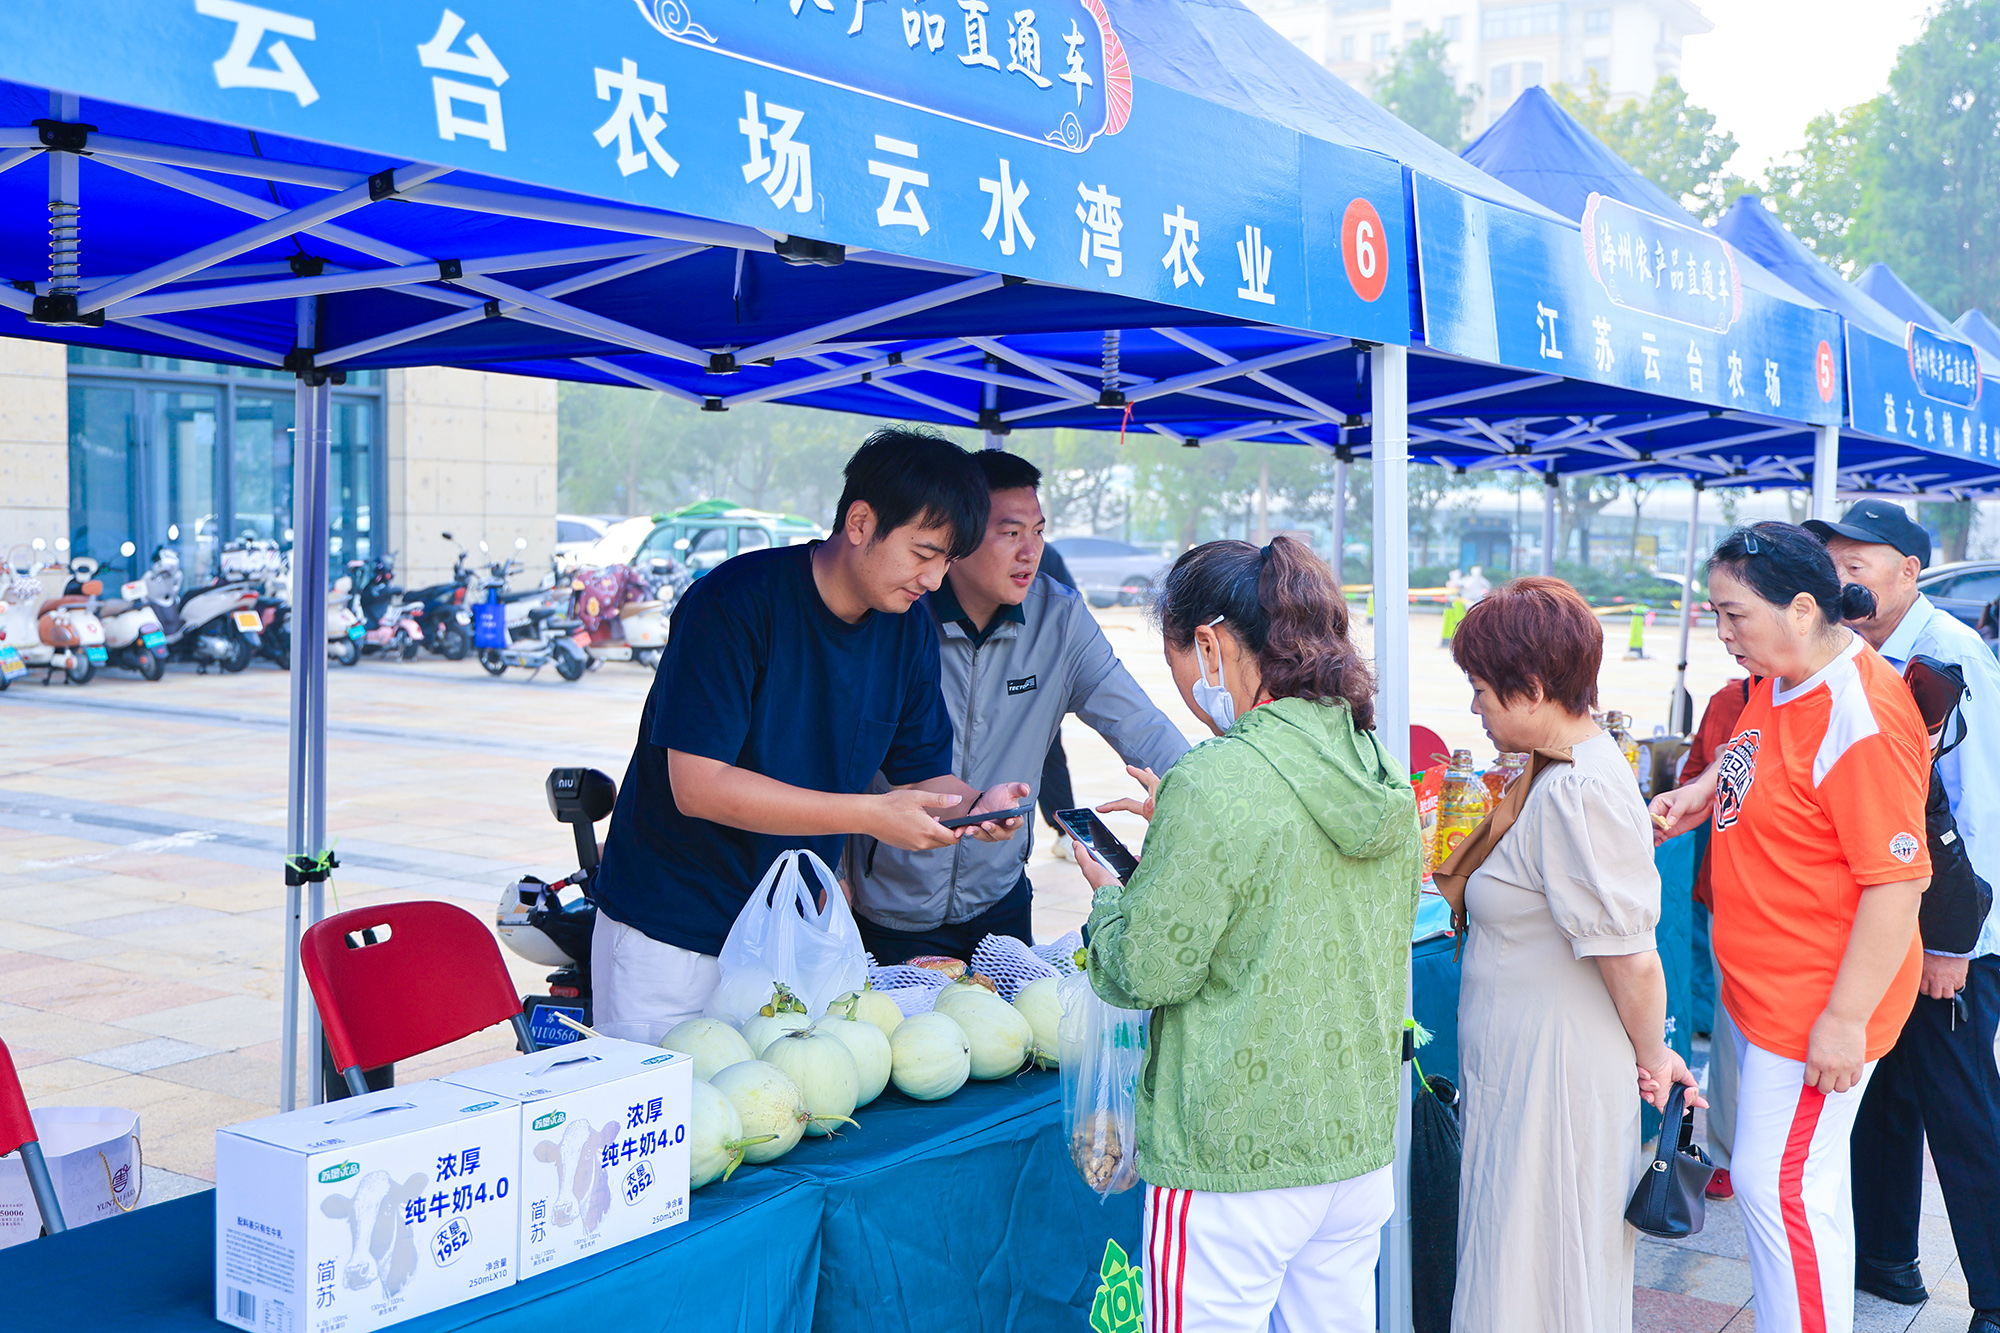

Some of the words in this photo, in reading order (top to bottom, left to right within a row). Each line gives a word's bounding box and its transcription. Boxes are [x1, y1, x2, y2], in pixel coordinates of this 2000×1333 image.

[789, 0, 1094, 107] 品直通车
[196, 0, 1276, 305] 云台农场云水湾农业
[1355, 220, 1377, 279] 6
[1600, 220, 1730, 307] 海州农产品直通车
[1536, 300, 1781, 407] 江苏云台农场
[1820, 353, 1830, 388] 5
[627, 1097, 663, 1129] 浓厚
[436, 1146, 481, 1182] 浓厚
[601, 1124, 685, 1169] 纯牛奶4.0
[627, 1164, 646, 1186] 农垦
[627, 1173, 653, 1201] 1952
[405, 1176, 509, 1226] 纯牛奶4.0
[665, 1197, 683, 1210] 净含量
[437, 1221, 461, 1246] 农垦
[437, 1231, 470, 1262] 1952
[469, 1269, 508, 1288] 250mLX10
[485, 1257, 507, 1272] 净含量
